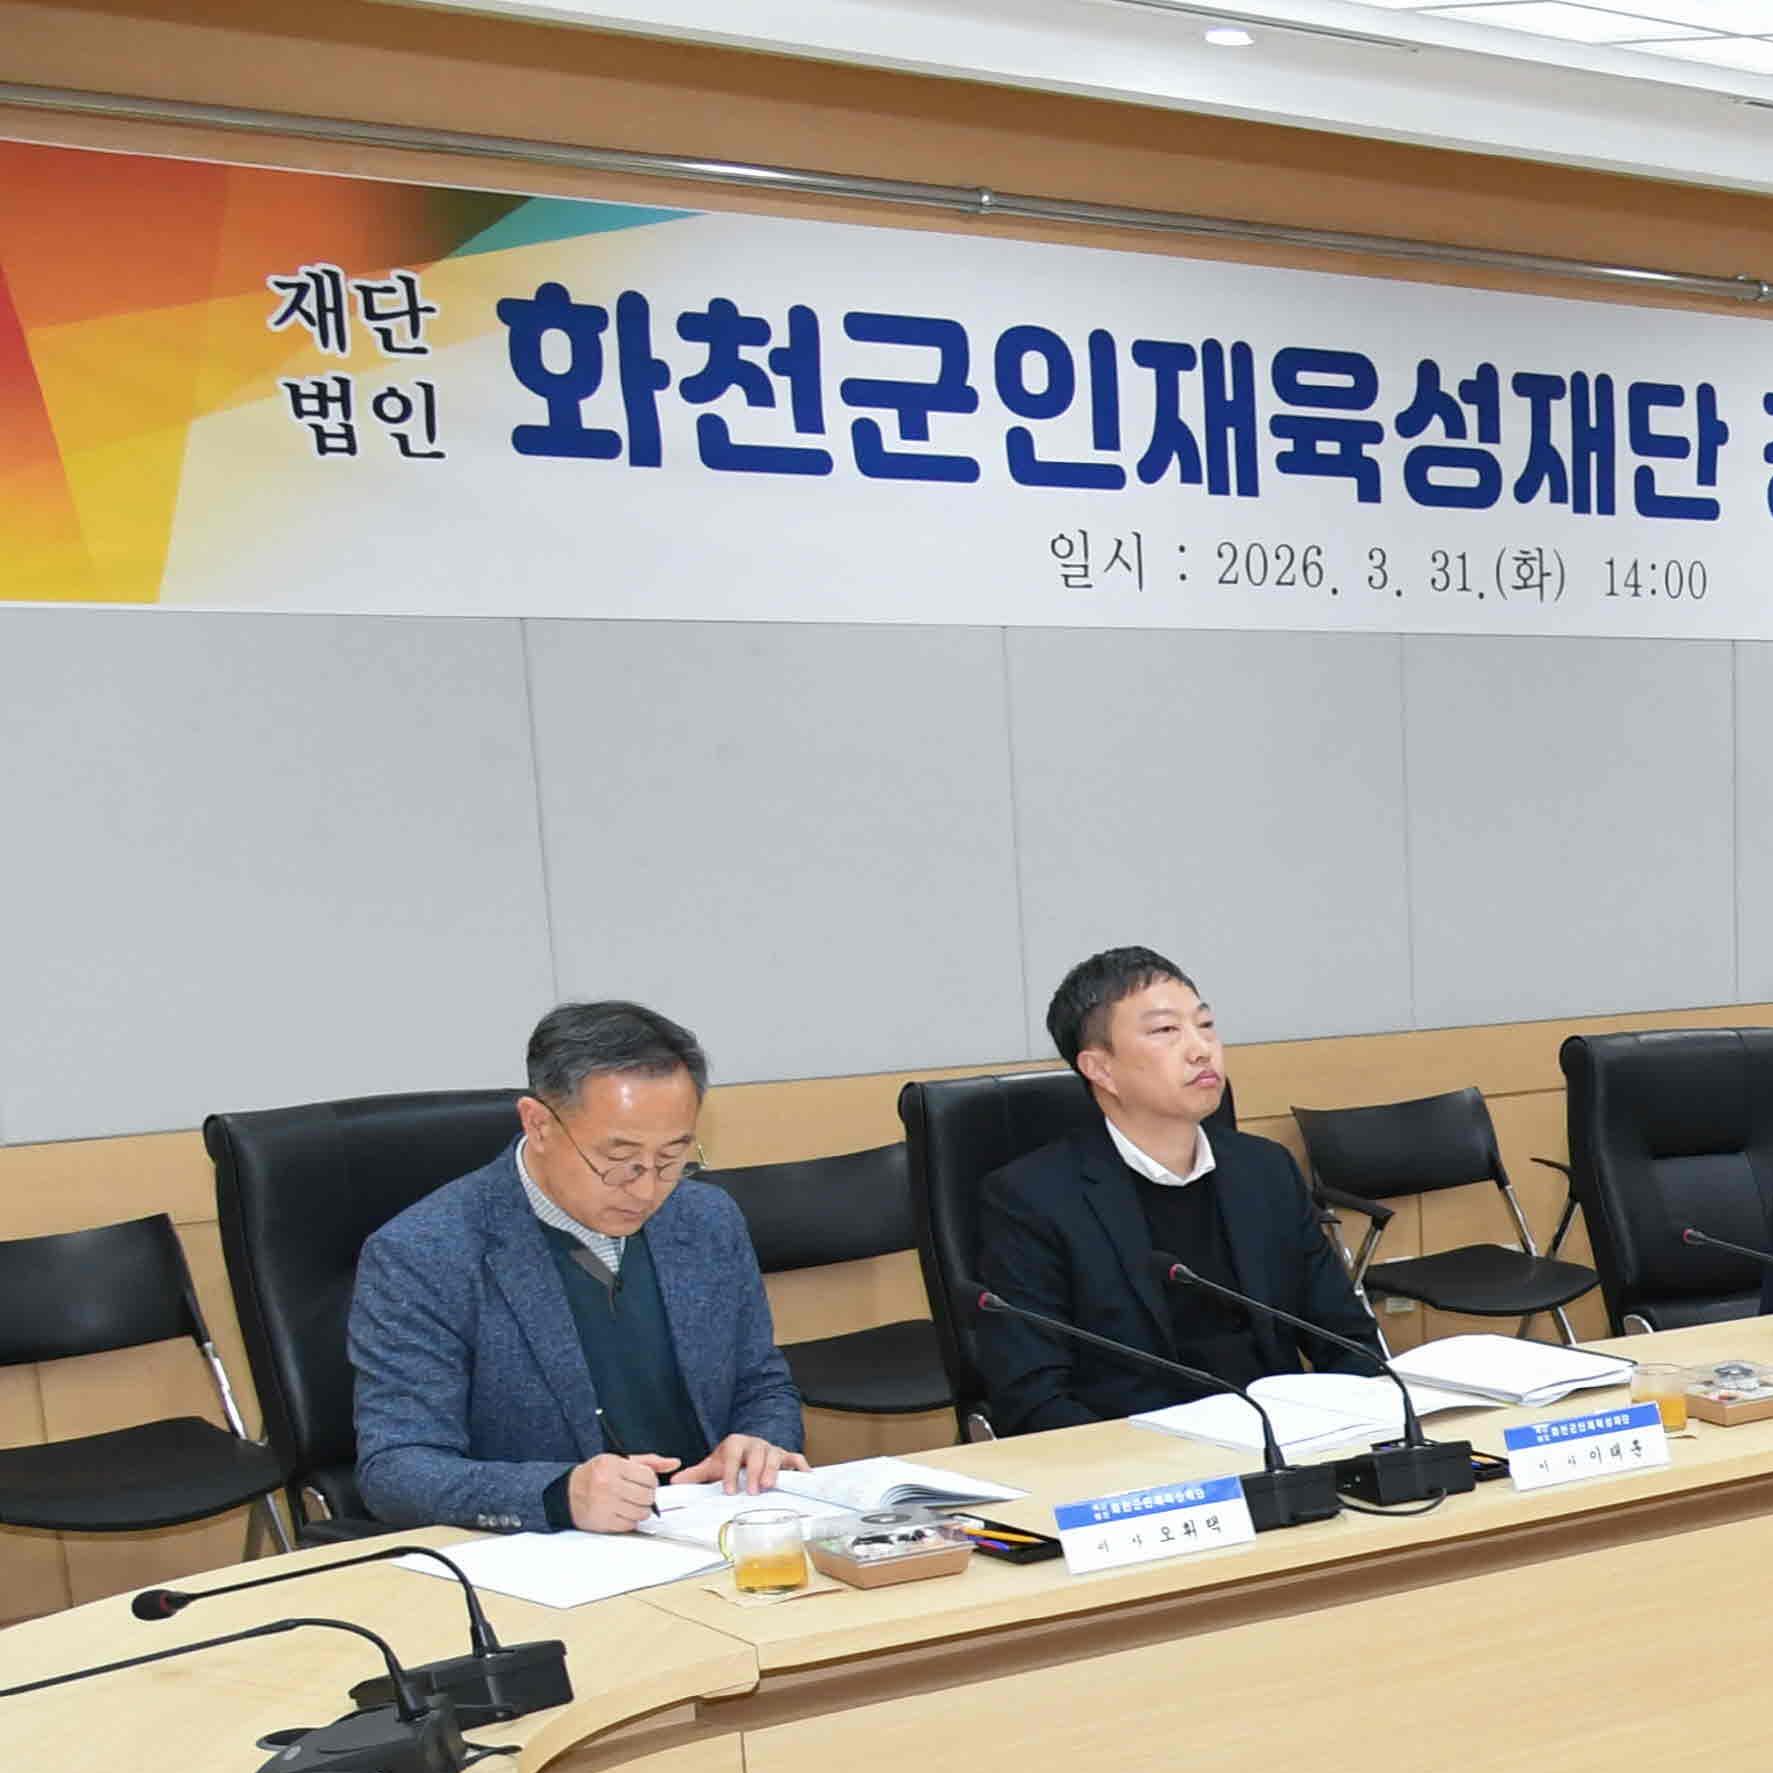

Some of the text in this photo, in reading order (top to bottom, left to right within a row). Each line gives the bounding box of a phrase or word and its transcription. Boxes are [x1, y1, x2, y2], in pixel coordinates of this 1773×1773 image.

[271, 267, 438, 357] 재단
[283, 375, 447, 461] 법인
[496, 281, 1731, 523] 화천군인재육성재단
[1050, 529, 1145, 592] 일시
[1217, 541, 1341, 597] 2026.
[1367, 547, 1405, 599] 3.
[1430, 546, 1567, 602] 31.(화)
[1604, 556, 1709, 602] 14:00
